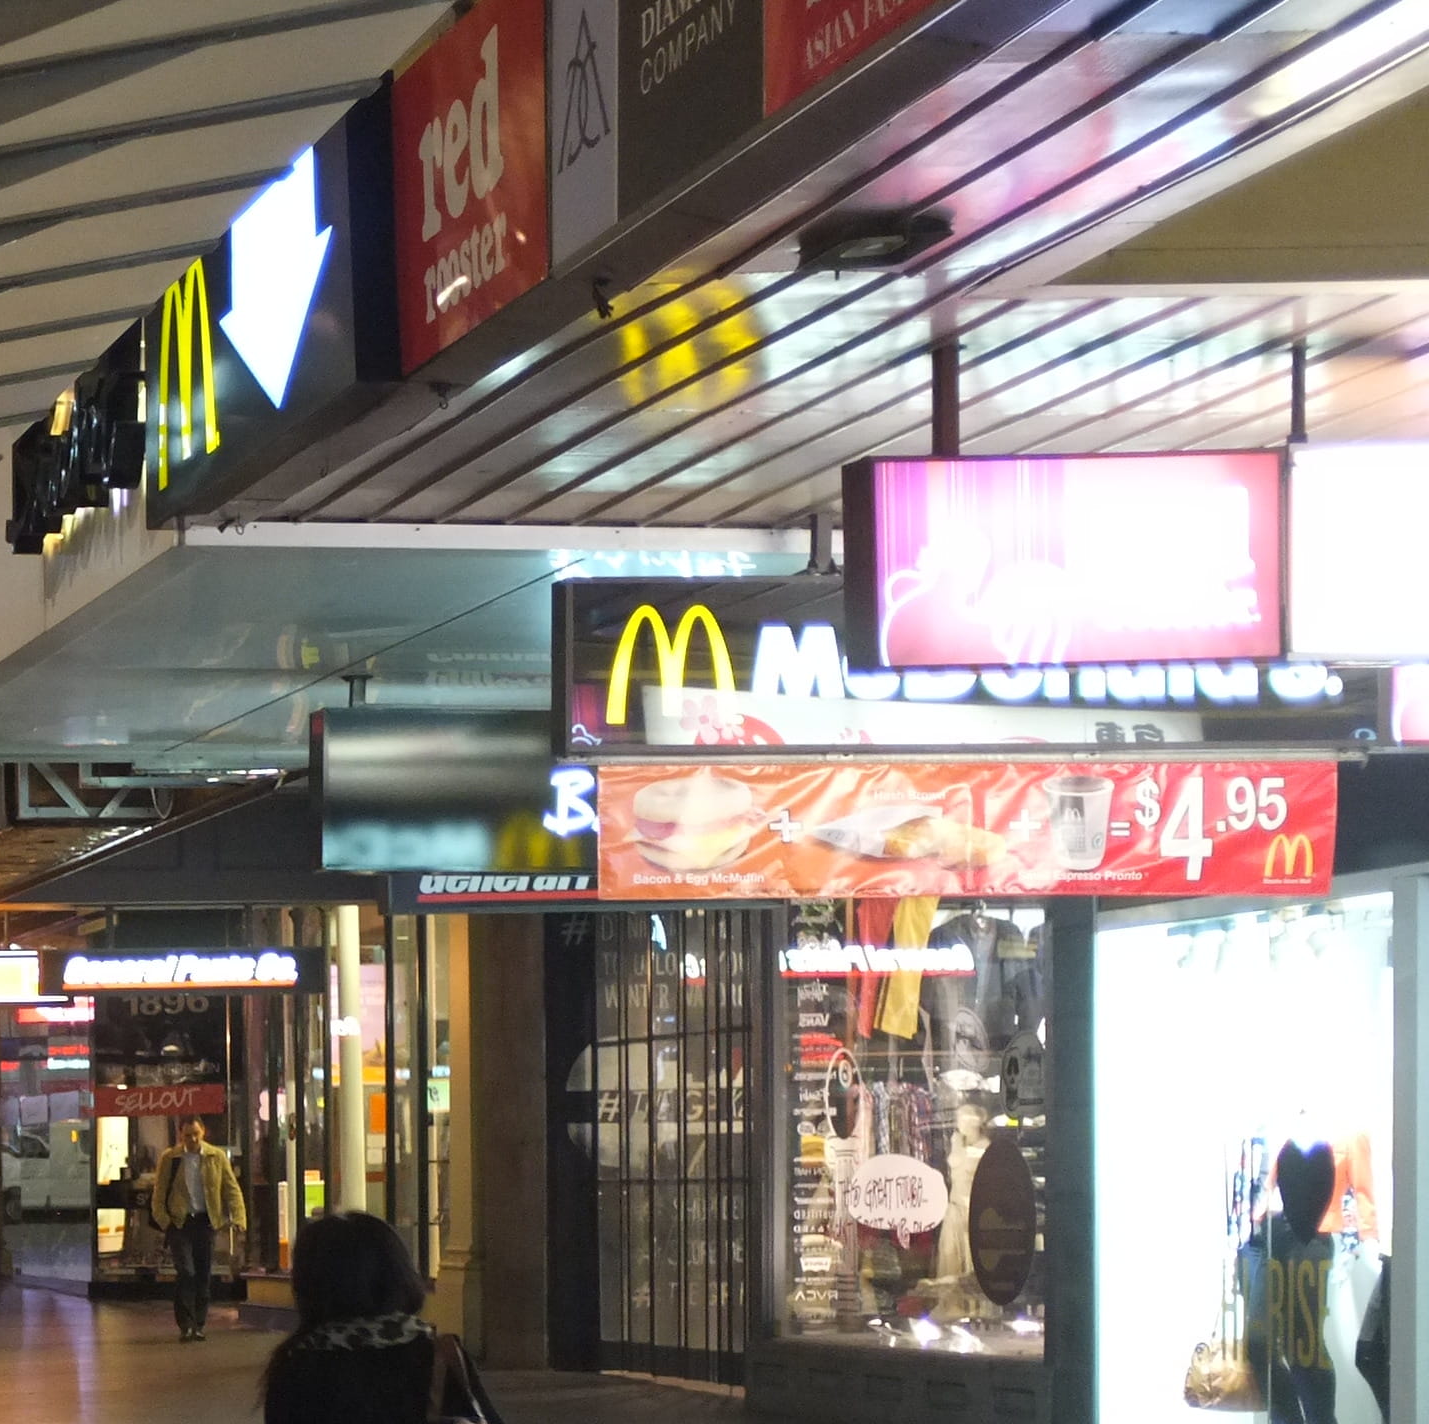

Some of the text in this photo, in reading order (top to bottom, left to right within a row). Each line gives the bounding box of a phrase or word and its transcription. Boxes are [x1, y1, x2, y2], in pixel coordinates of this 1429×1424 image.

[640, 0, 736, 95] COMPANY
[418, 23, 504, 243] red
[423, 211, 507, 325] rooster
[753, 622, 1329, 701] Mconas
[1134, 775, 1288, 881] $4.95
[633, 873, 671, 885] Bacon
[686, 873, 709, 886] Egg
[711, 872, 765, 885] McMuffin
[1053, 871, 1102, 884] Espresso
[1104, 870, 1144, 882] Pronto
[120, 993, 210, 1017] 1896
[114, 1086, 201, 1114] SELLOUT
